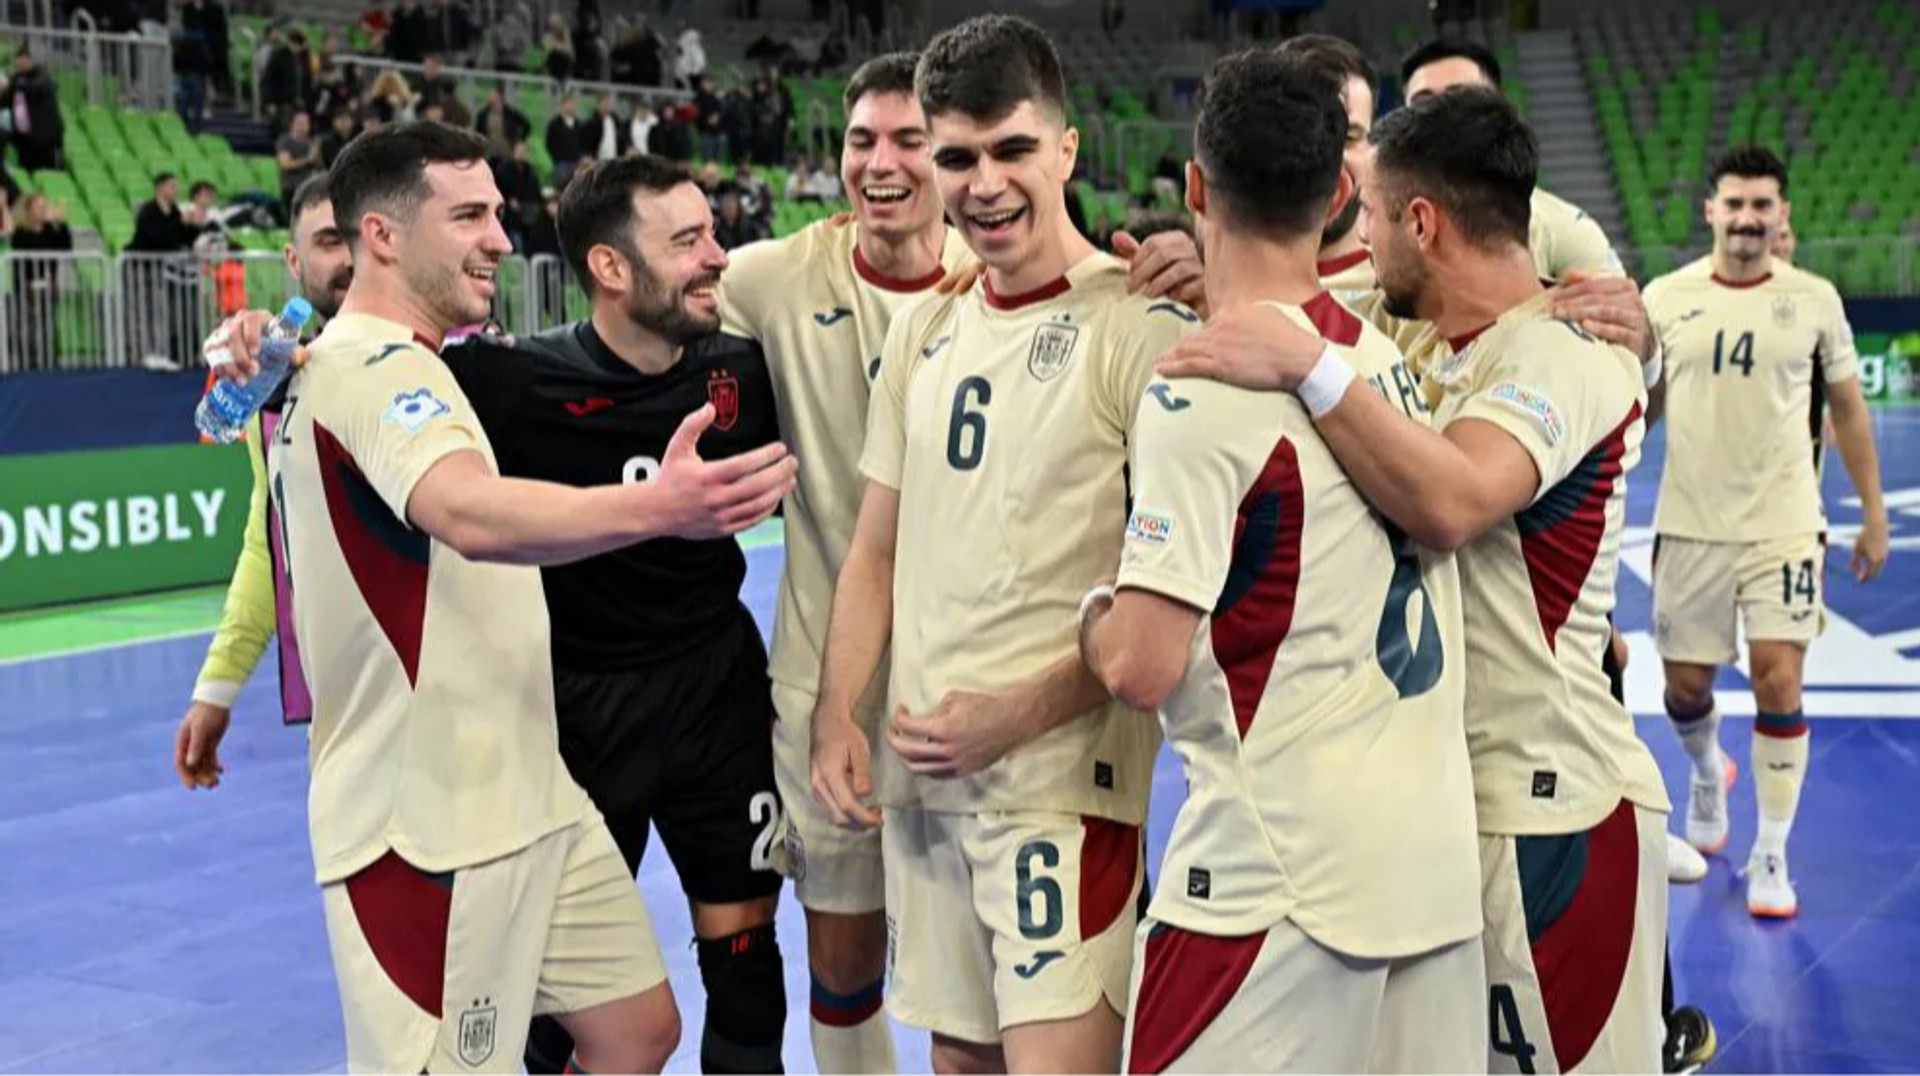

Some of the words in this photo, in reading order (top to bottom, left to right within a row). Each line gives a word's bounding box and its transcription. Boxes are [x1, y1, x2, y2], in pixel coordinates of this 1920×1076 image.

[1713, 328, 1755, 377] 14
[947, 375, 991, 470] 6
[1782, 558, 1815, 605] 14
[1016, 840, 1063, 940] 6
